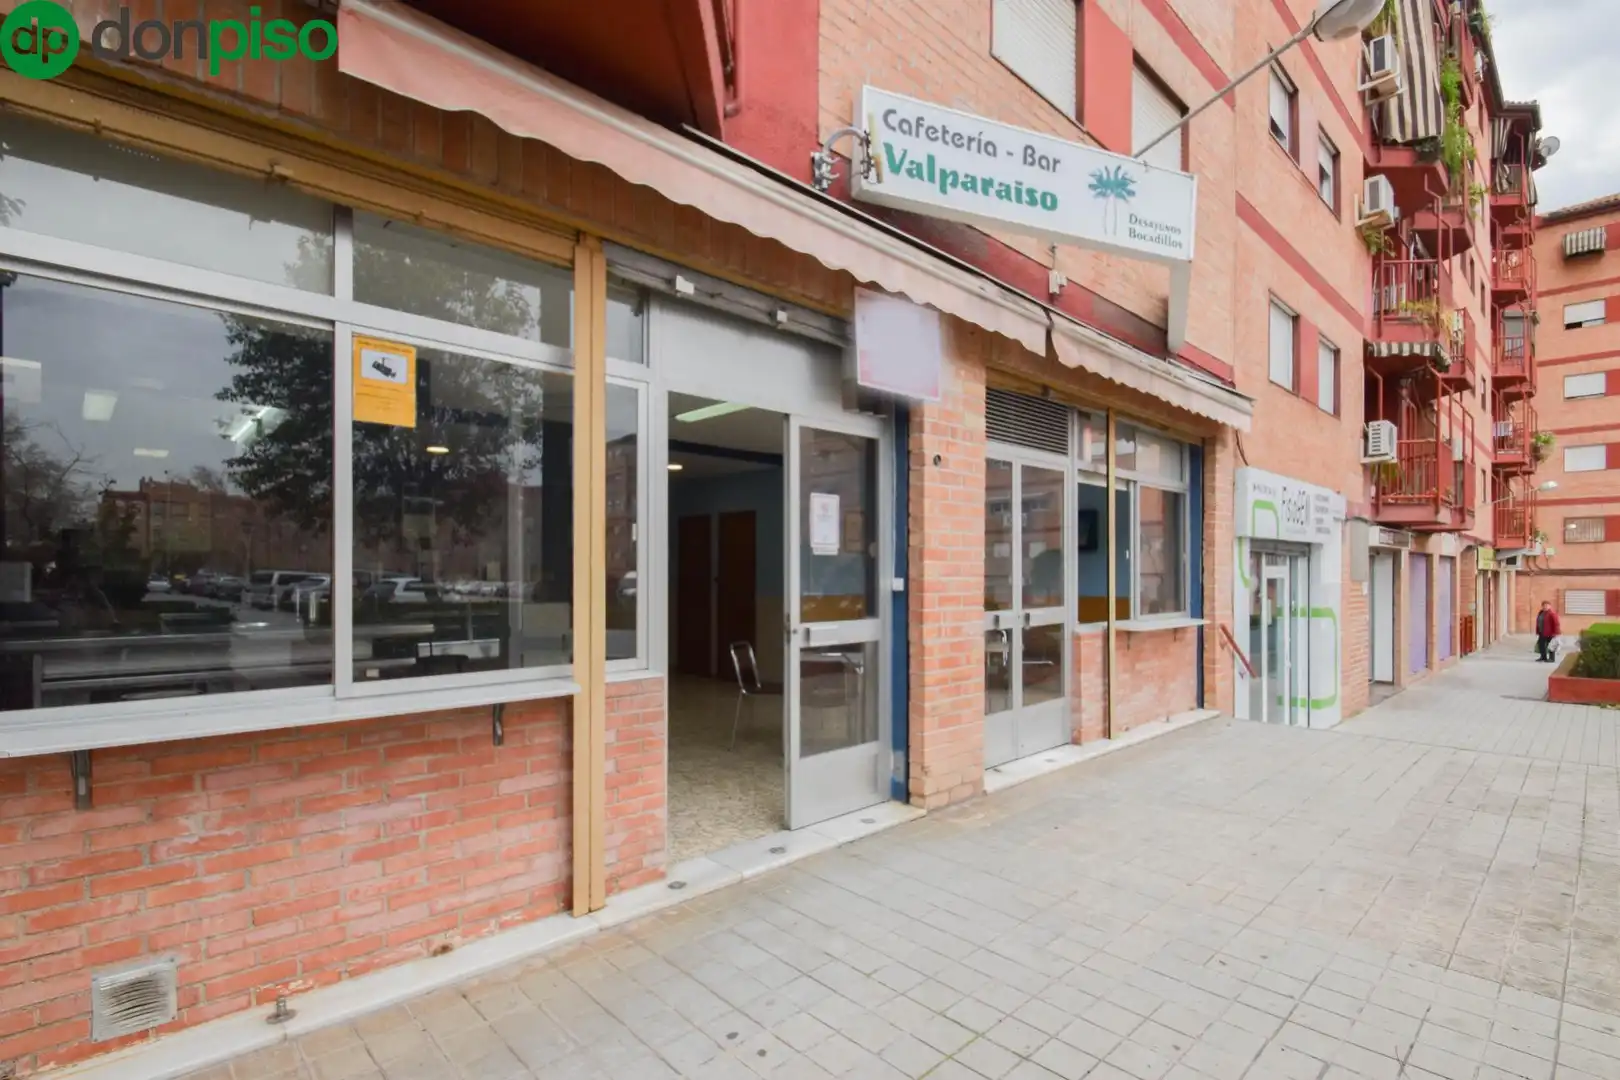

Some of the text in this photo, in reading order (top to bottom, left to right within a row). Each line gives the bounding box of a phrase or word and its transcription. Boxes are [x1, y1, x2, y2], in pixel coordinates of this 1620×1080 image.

[882, 108, 998, 158] Cafetería
[1022, 144, 1062, 174] Bar
[1128, 227, 1183, 249] Bocadillos
